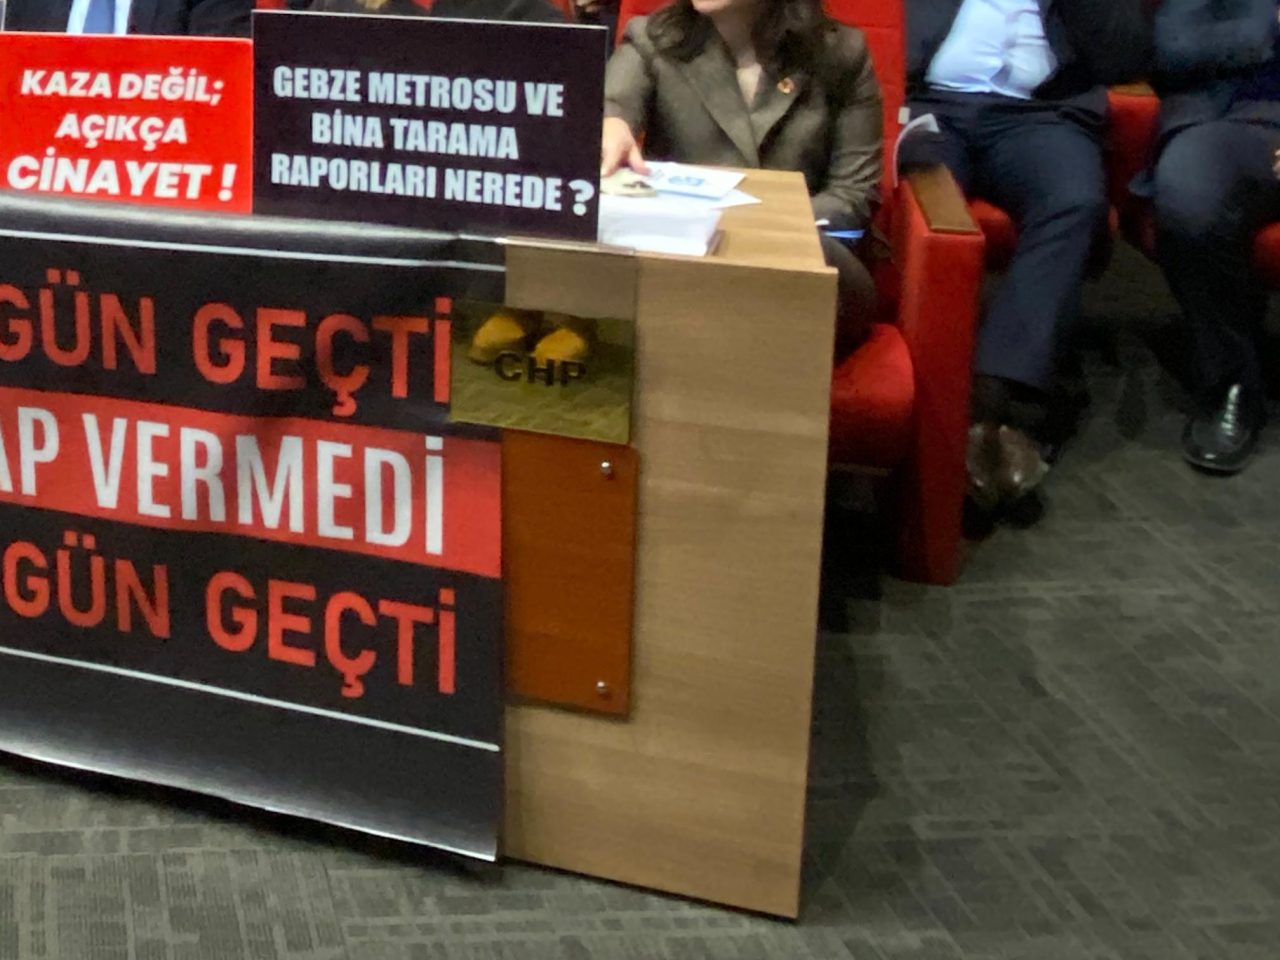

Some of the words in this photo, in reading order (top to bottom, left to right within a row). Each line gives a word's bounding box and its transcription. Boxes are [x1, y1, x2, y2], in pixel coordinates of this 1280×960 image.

[21, 70, 112, 98] KAZA
[118, 66, 224, 106] DEĞİL;
[273, 65, 361, 102] GEBZE
[367, 72, 517, 114] METROSU
[524, 82, 564, 117] VE
[55, 113, 187, 151] AÇIKÇA
[312, 109, 383, 149] BİNA
[389, 118, 519, 160] TARAMA
[7, 146, 212, 200] CİNAYET
[271, 153, 436, 198] RAPORLARI
[444, 168, 562, 211] NEREDE
[191, 297, 452, 416] GEÇTİ
[494, 351, 587, 386] CHP
[82, 413, 444, 555] VERMEDİ
[3, 532, 171, 638] GÜN
[205, 588, 456, 698] GEÇTİ
